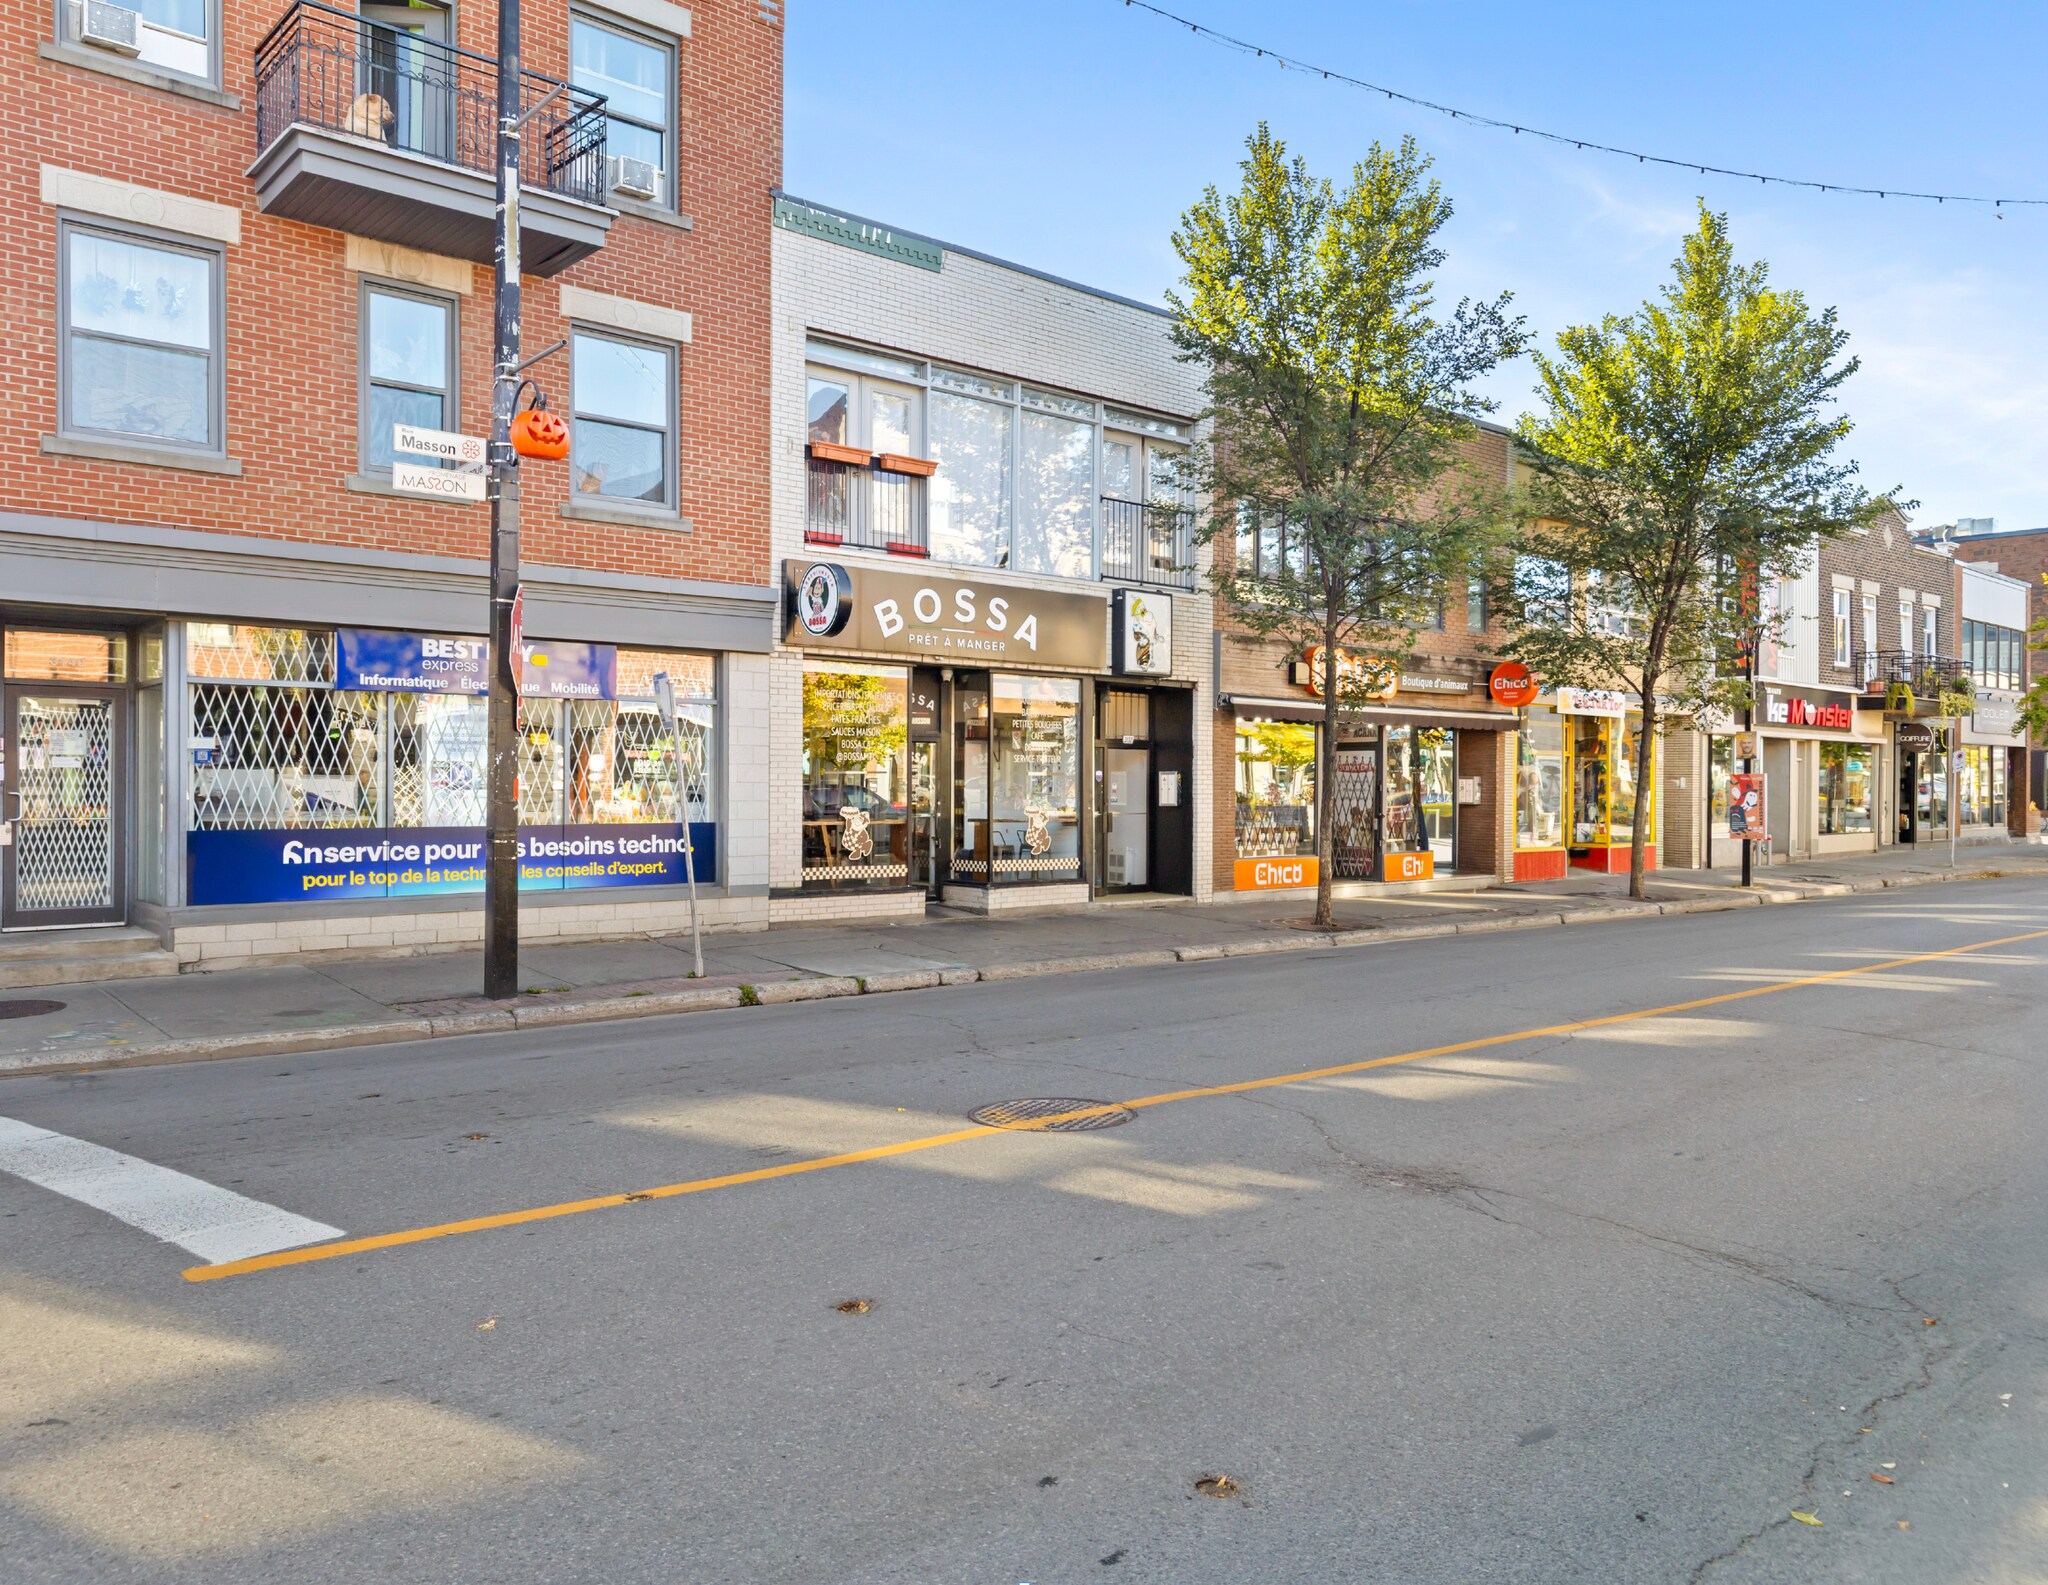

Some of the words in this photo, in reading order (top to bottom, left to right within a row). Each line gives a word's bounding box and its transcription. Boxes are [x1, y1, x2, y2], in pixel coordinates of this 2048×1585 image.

[402, 434, 456, 455] Masson
[402, 475, 467, 493] MASSON
[808, 616, 827, 626] BOSSA
[873, 588, 1037, 651] BOSSA
[422, 638, 480, 660] BEST
[908, 633, 938, 647] PRÊT
[944, 634, 951, 647] À
[957, 637, 1006, 652] MANGER
[422, 658, 479, 673] express
[359, 673, 448, 689] Informatique
[551, 681, 599, 695] Mobilité
[1402, 676, 1433, 689] Boutique
[1434, 678, 1468, 690] d'animaux
[831, 726, 855, 736] SAUCES
[856, 727, 881, 737] MAISON
[424, 843, 482, 864] pour
[530, 835, 615, 857] besoins
[303, 874, 346, 890] pour
[349, 870, 366, 886] le
[368, 870, 398, 887] top
[401, 868, 424, 883] de
[426, 868, 441, 882] la
[521, 865, 543, 879] les
[545, 861, 605, 878] conseils
[607, 861, 668, 877] d'expert.
[1255, 862, 1303, 886] Chico
